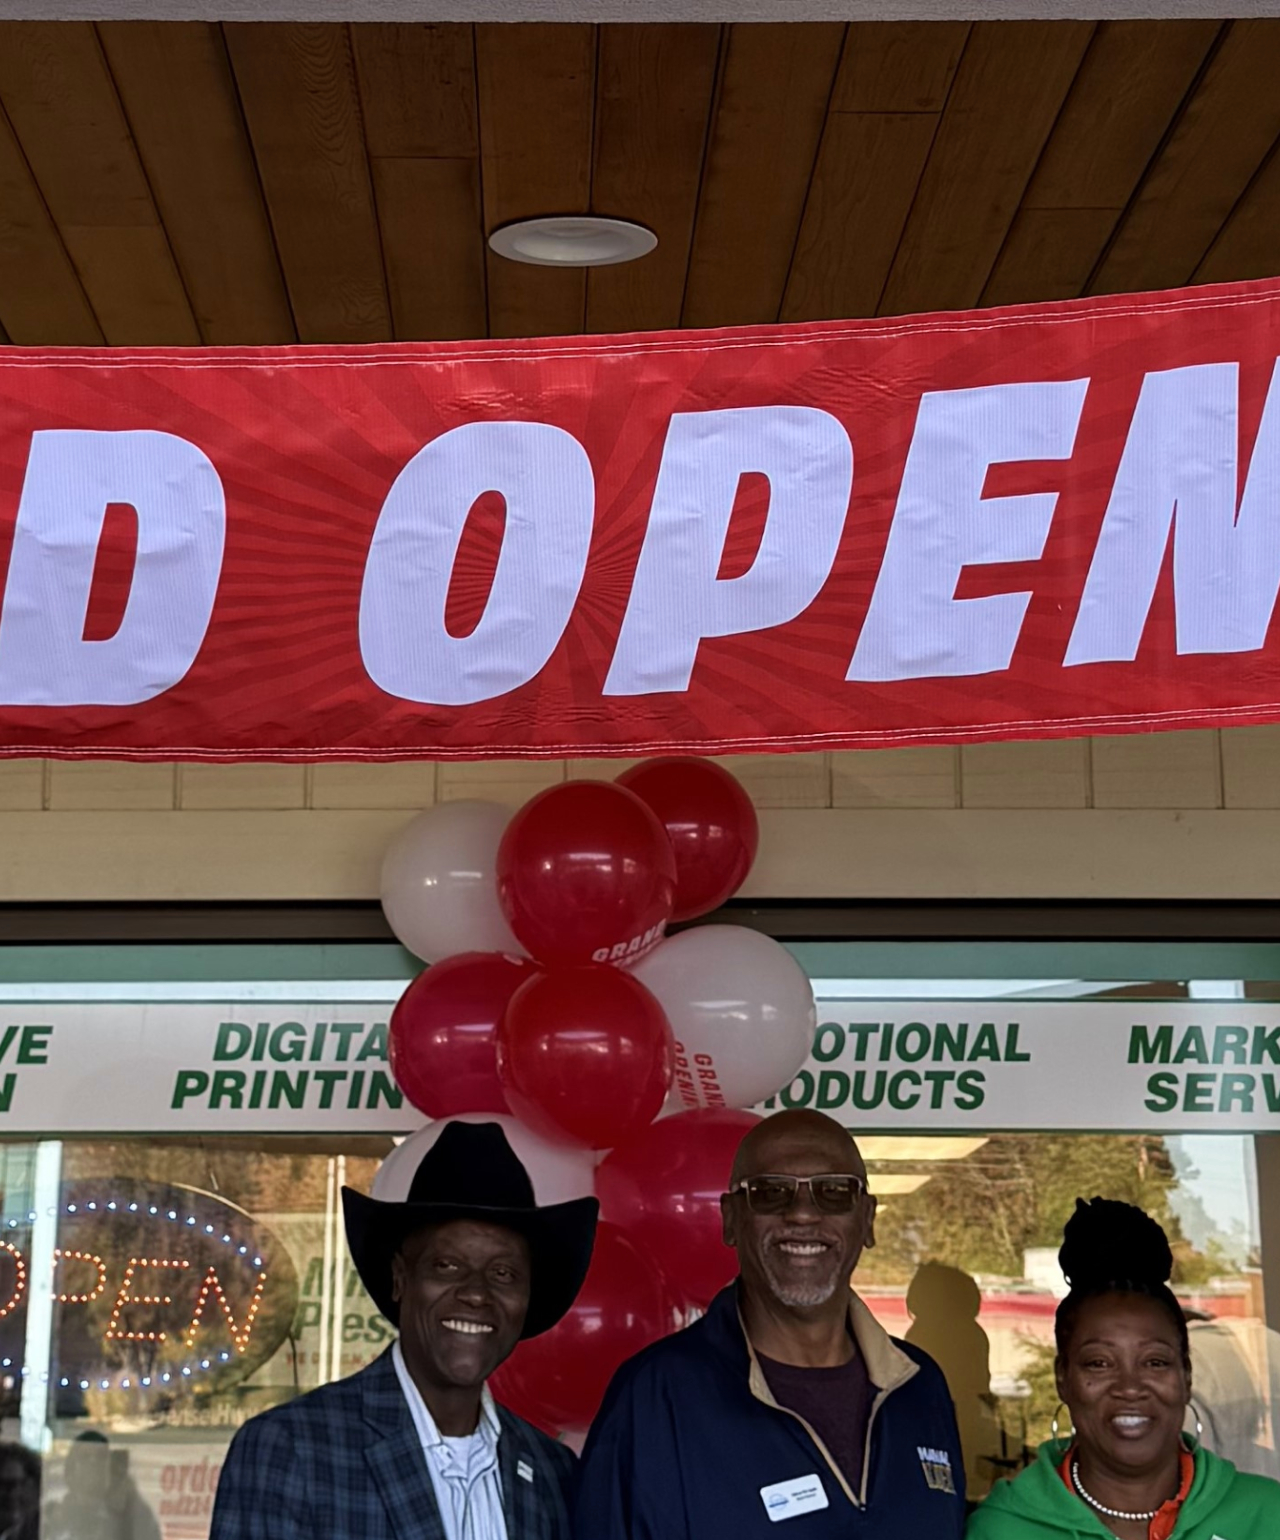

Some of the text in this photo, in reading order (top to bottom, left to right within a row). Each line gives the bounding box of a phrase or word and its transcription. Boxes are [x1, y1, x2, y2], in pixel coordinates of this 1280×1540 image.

[212, 1022, 389, 1062] DIGITA
[811, 1022, 1031, 1062] OTIONAL
[171, 1070, 405, 1109] PRINTIN
[754, 1069, 986, 1110] ODUCTS
[292, 1302, 395, 1343] Pres
